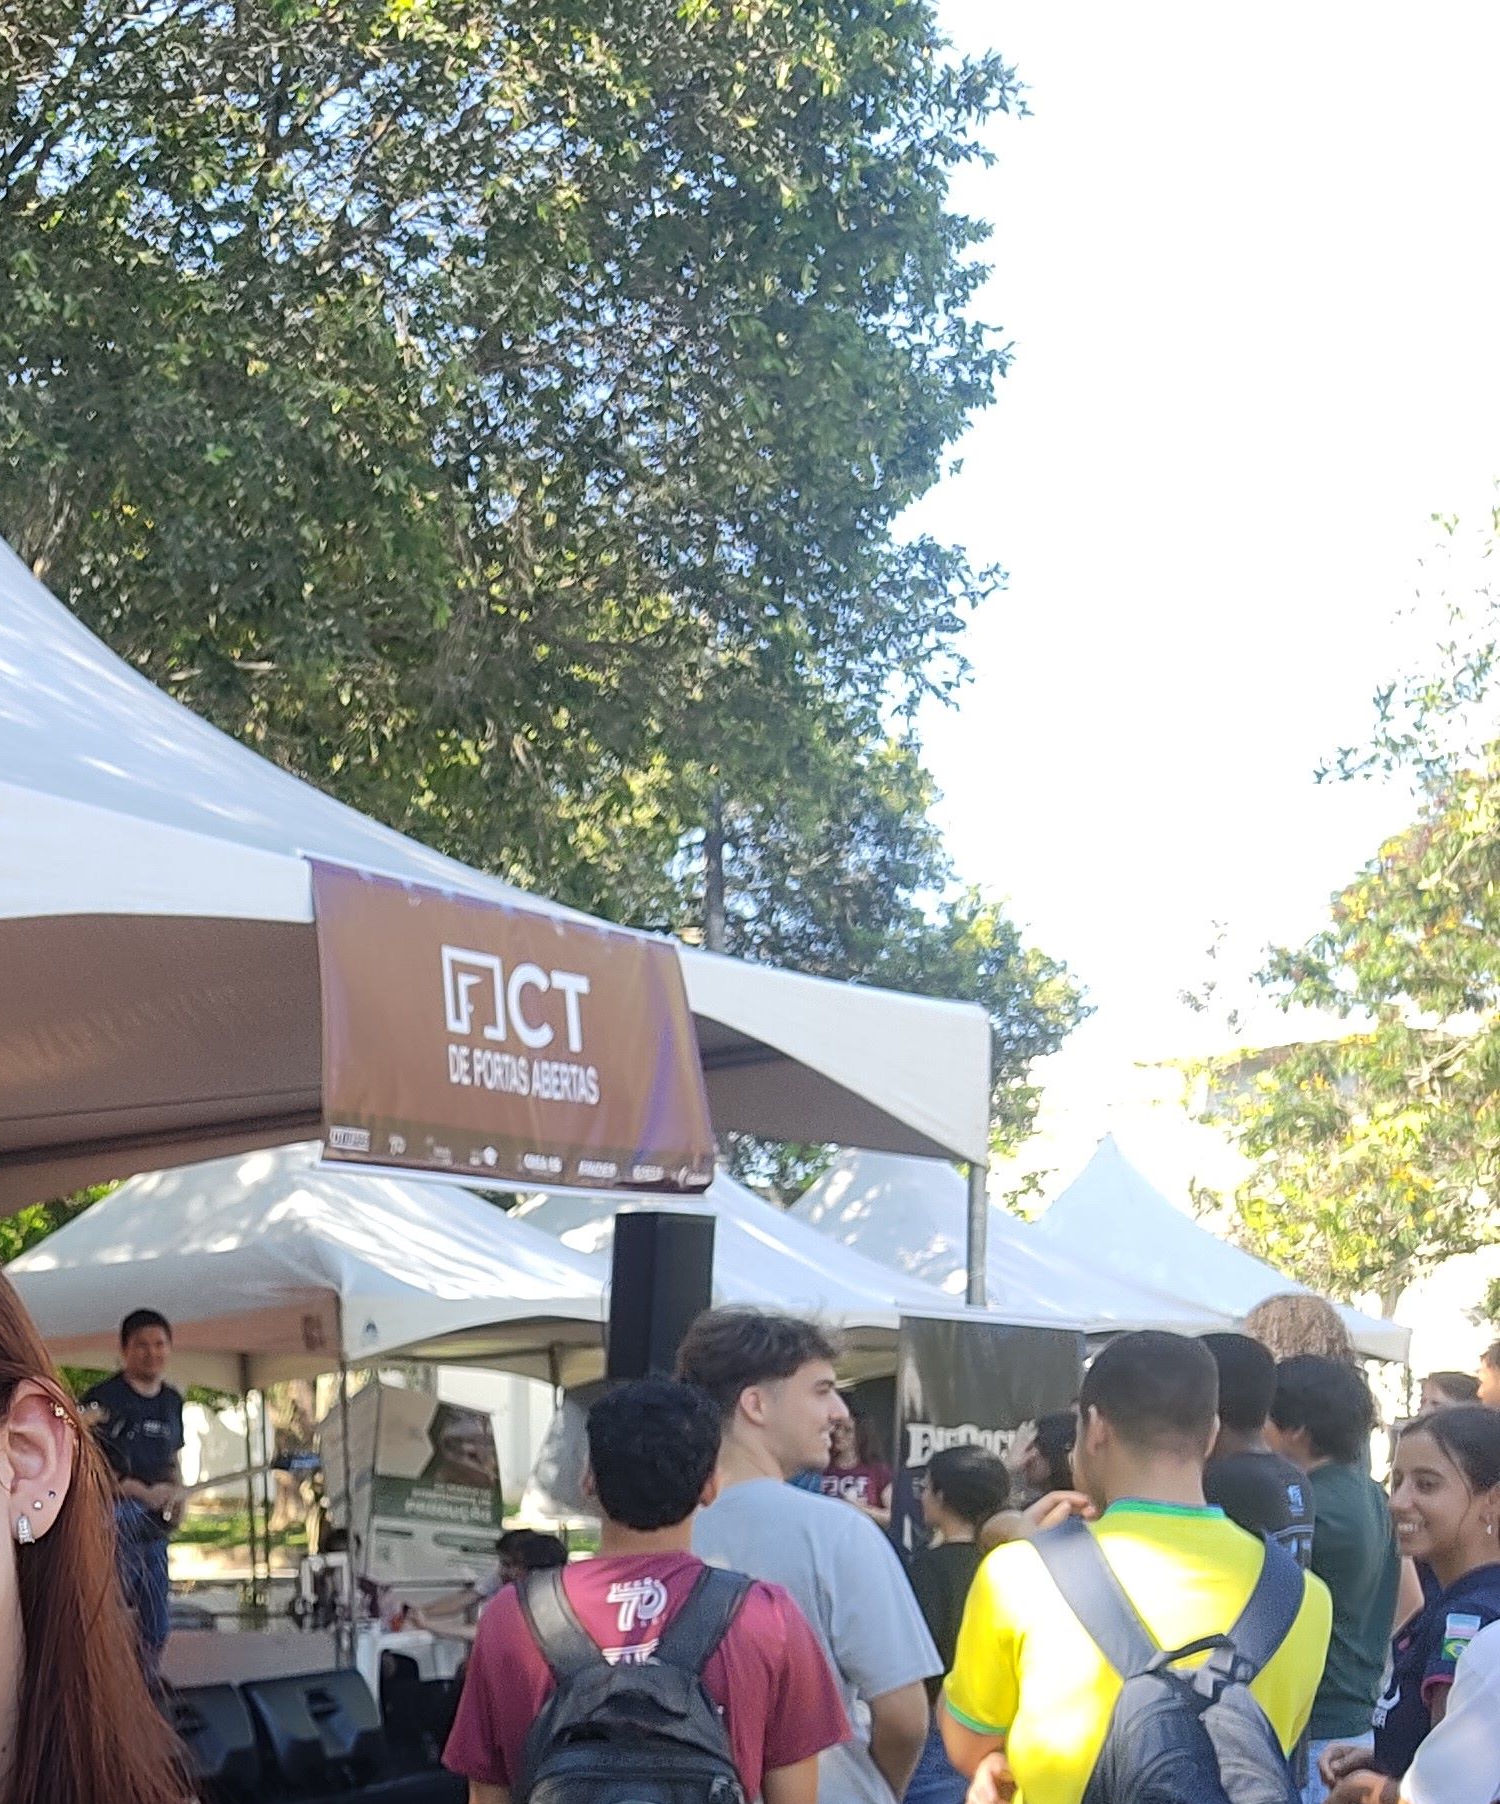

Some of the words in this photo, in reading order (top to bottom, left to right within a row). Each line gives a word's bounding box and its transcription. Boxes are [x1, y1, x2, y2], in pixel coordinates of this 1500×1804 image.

[448, 1044, 472, 1085] DE
[473, 1049, 530, 1096] PORTAS
[531, 1059, 600, 1105] ABERTAS
